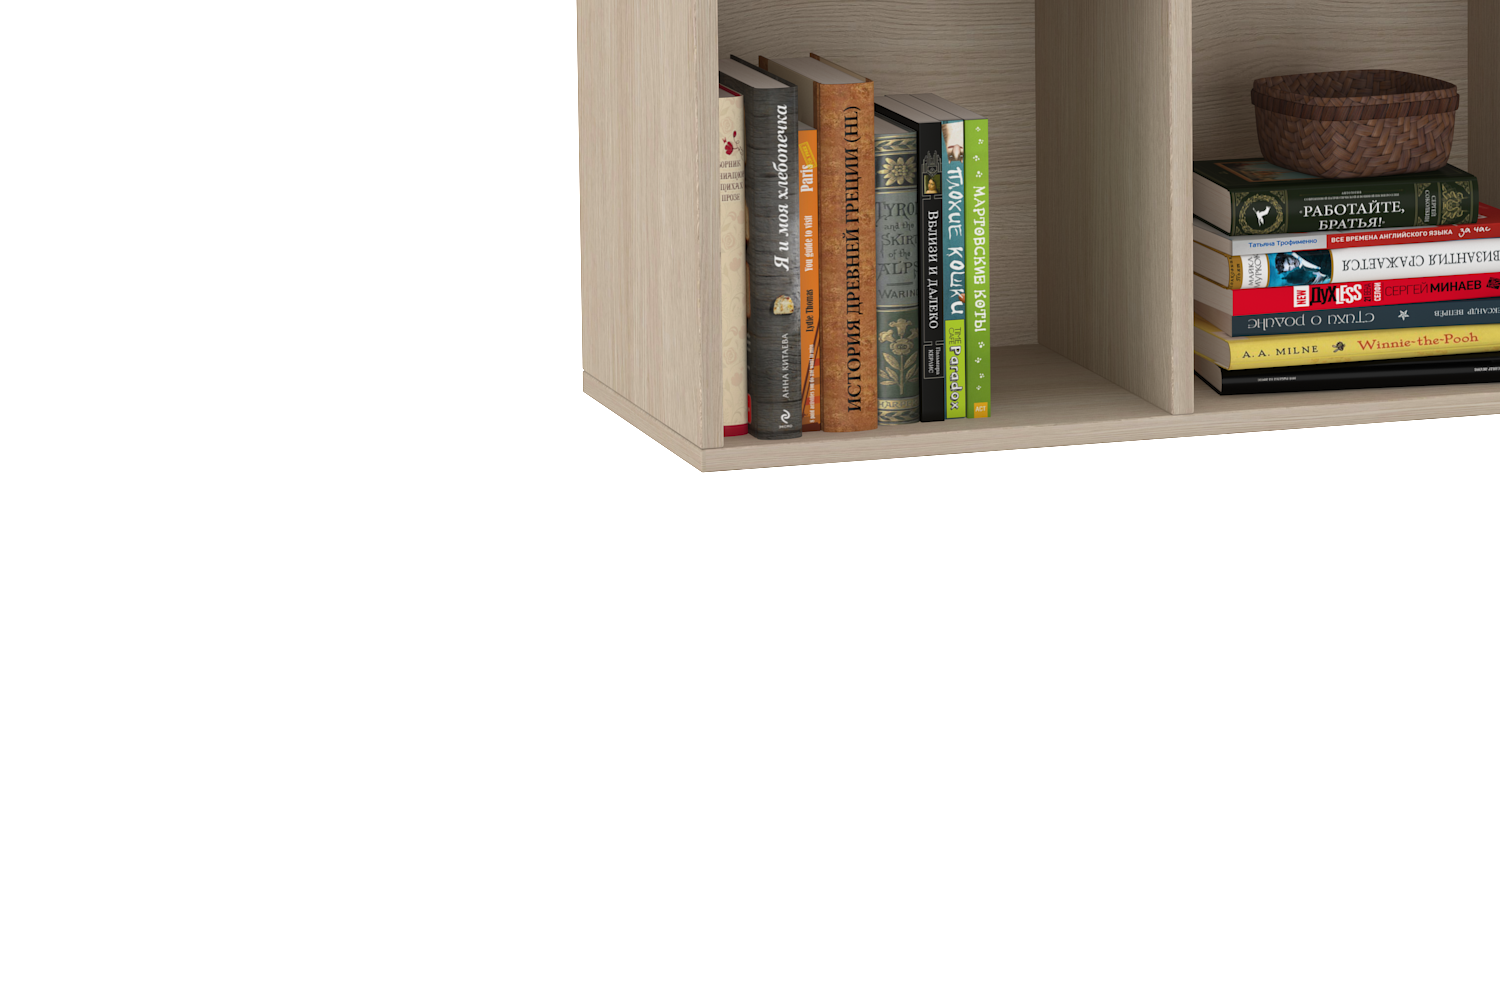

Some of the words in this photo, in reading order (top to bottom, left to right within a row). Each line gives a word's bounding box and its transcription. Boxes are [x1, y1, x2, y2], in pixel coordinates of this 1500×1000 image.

[772, 103, 789, 200] хлебопечка
[719, 160, 741, 168] ОРНИК
[800, 164, 814, 192] Paris
[844, 147, 862, 224] ГРЕЦИИ
[778, 204, 789, 237] моя
[804, 215, 813, 227] visit
[875, 201, 918, 224] TYRO
[884, 222, 900, 231] and
[902, 221, 914, 231] the
[973, 185, 986, 285] МАРТОВСКИЕ
[1346, 234, 1378, 243] ВРЕМЕНА
[1378, 230, 1428, 240] АНГЛИЙСКОГО
[1458, 227, 1471, 238] за
[1474, 225, 1491, 233] час
[778, 240, 790, 251] и
[804, 236, 814, 256] guide
[1276, 238, 1318, 247] Трофименко
[774, 254, 790, 272] Я
[888, 249, 898, 259] of
[899, 249, 911, 260] the
[1342, 255, 1425, 271] СРАЖАЕТСЯ
[1428, 250, 1500, 266] ВИЗАНТИЯ
[804, 257, 814, 272] You
[842, 228, 863, 315] ДРЕВНЕЙ
[878, 289, 919, 299] WARIN
[1296, 289, 1308, 305] NEW
[1385, 282, 1429, 297] СЕРГЕЙ
[1430, 280, 1482, 293] МИНАЕВ
[805, 289, 814, 314] Thomas
[974, 289, 987, 333] КОТЫ
[805, 315, 814, 332] Lydie
[954, 327, 962, 344] TIME
[781, 333, 789, 371] КИТАЕВА
[1242, 350, 1255, 358] A.
[1258, 349, 1270, 357] A.
[1276, 345, 1319, 356] MILNE
[1357, 332, 1479, 351] Winnie-the-Pooh
[846, 319, 862, 412] ИСТОРИЯ
[949, 345, 963, 411] Paradox
